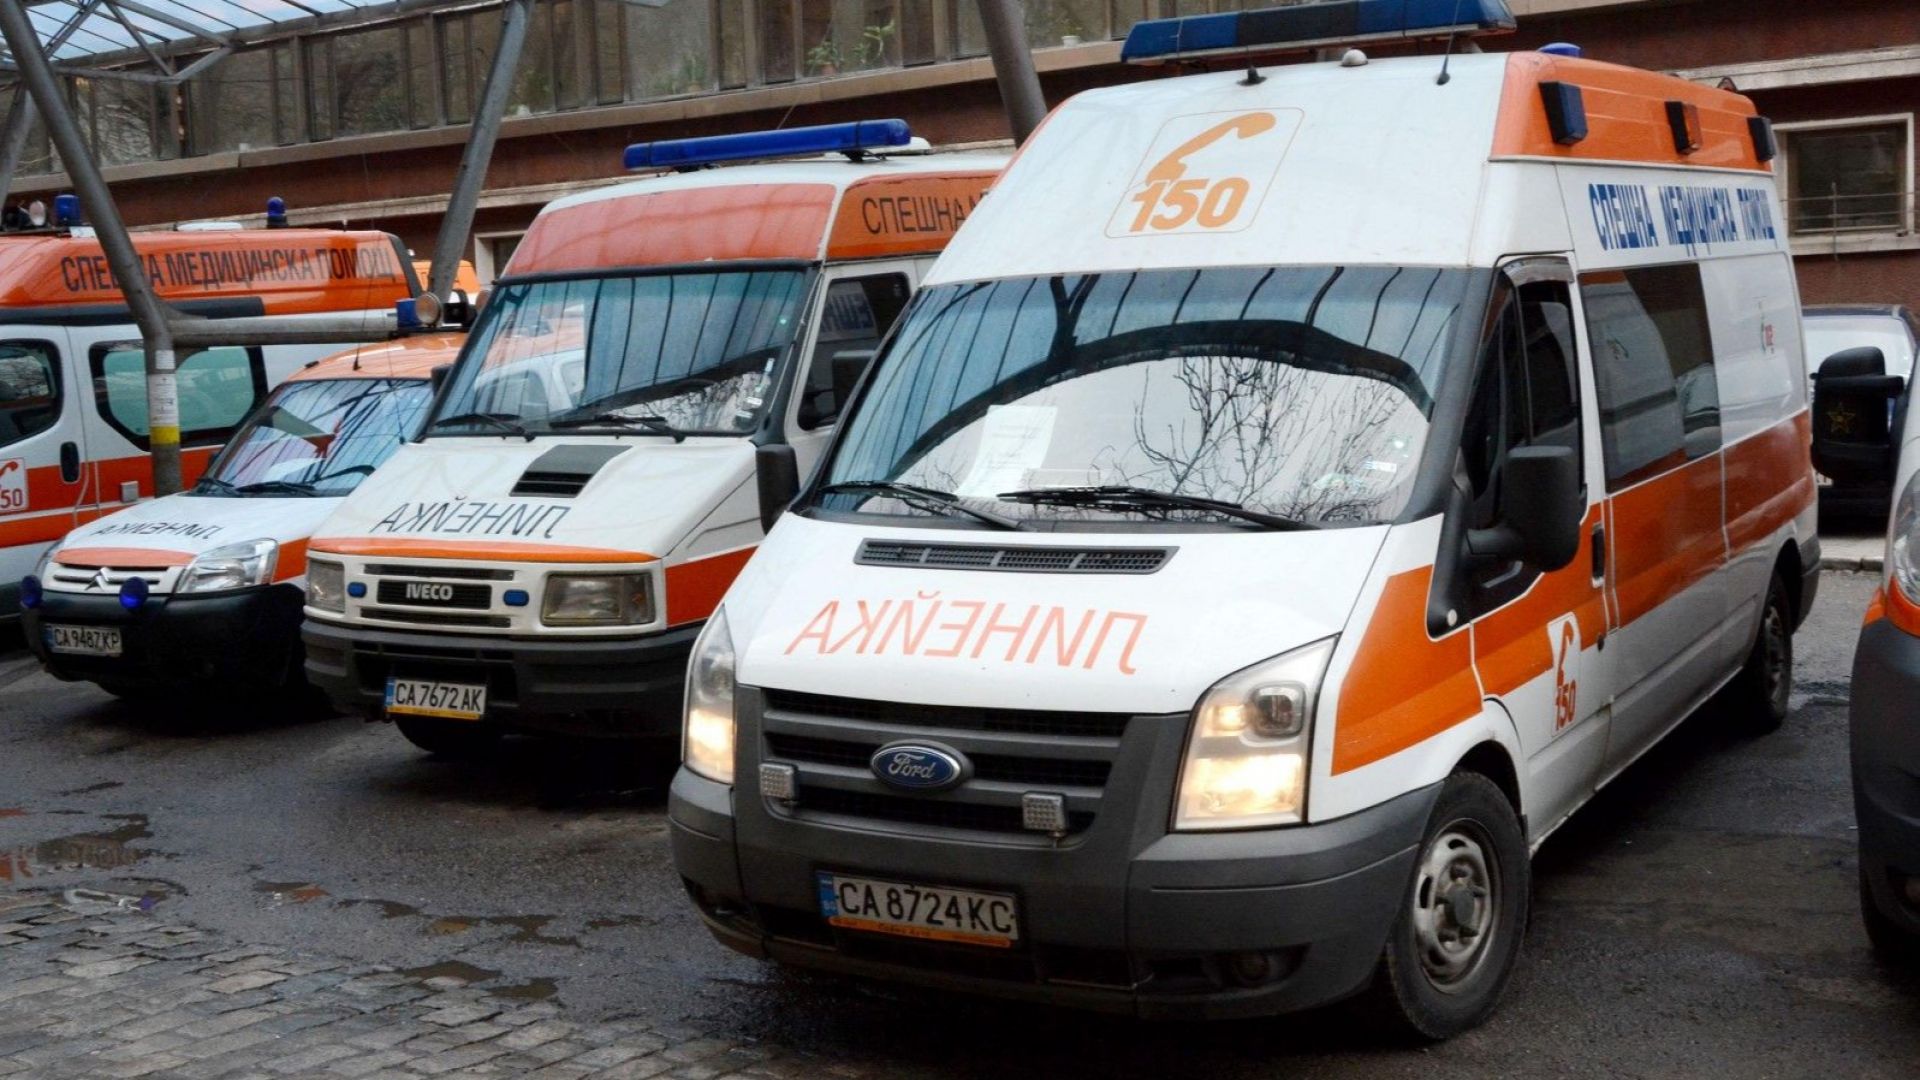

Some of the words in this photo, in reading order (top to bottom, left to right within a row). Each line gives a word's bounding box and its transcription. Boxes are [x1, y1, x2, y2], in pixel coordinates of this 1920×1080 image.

[1129, 177, 1250, 232] 150
[60, 253, 166, 292] СПЕА
[166, 248, 316, 290] МЕДИЦИНСКА
[315, 246, 396, 283] ПОМОЩ
[0, 488, 23, 509] 50
[406, 583, 453, 600] IVECO
[1555, 680, 1576, 731] 150
[888, 752, 936, 778] Ford
